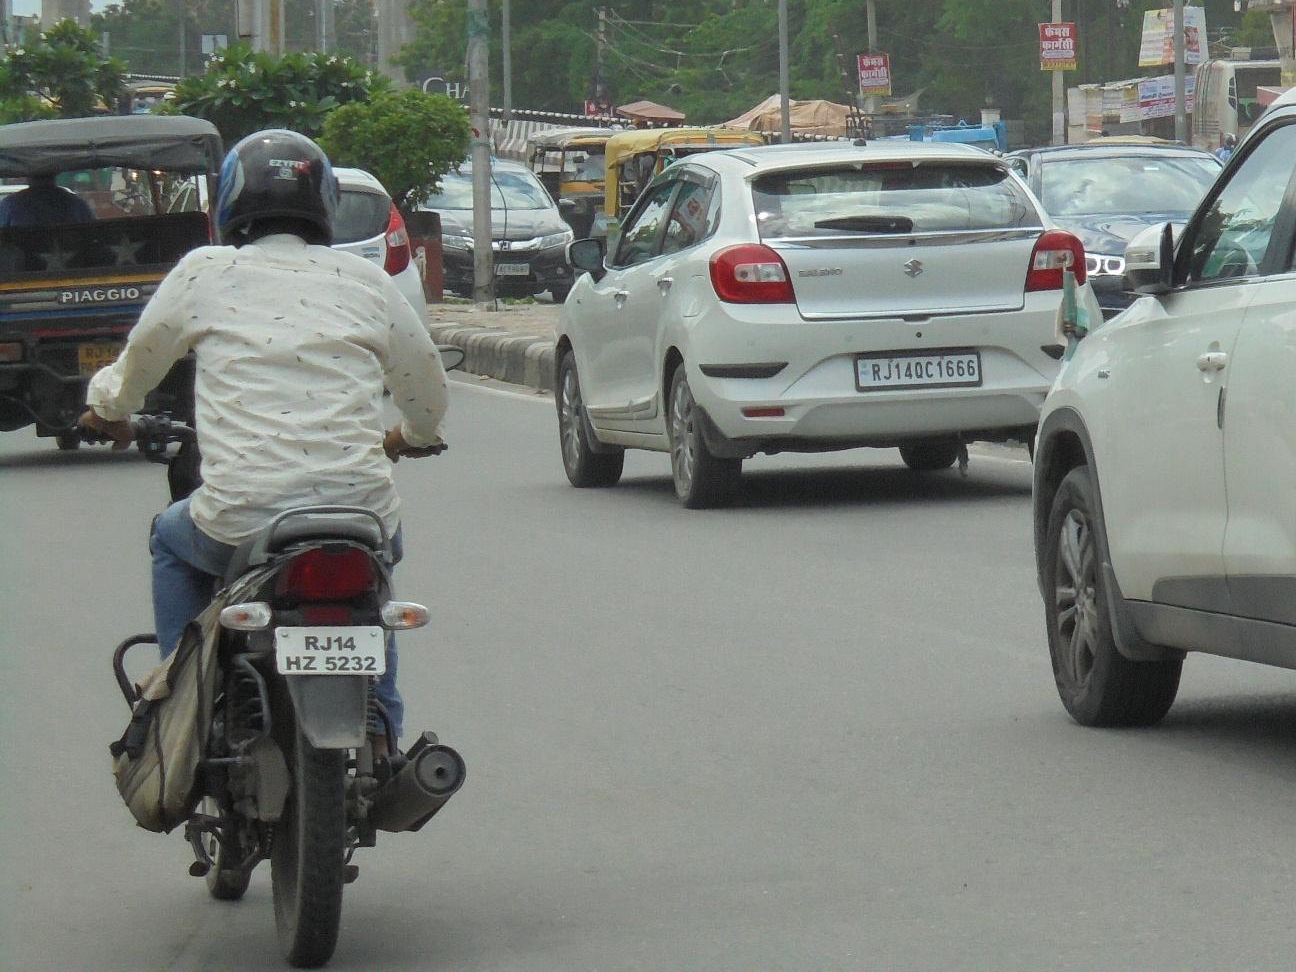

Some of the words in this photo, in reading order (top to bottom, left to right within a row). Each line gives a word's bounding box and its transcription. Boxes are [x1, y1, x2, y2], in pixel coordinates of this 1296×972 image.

[269, 159, 305, 169] EZYFIT
[61, 287, 140, 303] PIAGGIO
[871, 359, 976, 382] RJ14QC1666
[304, 635, 357, 651] RJ14
[286, 656, 318, 671] HZ
[325, 656, 377, 671] 5232
